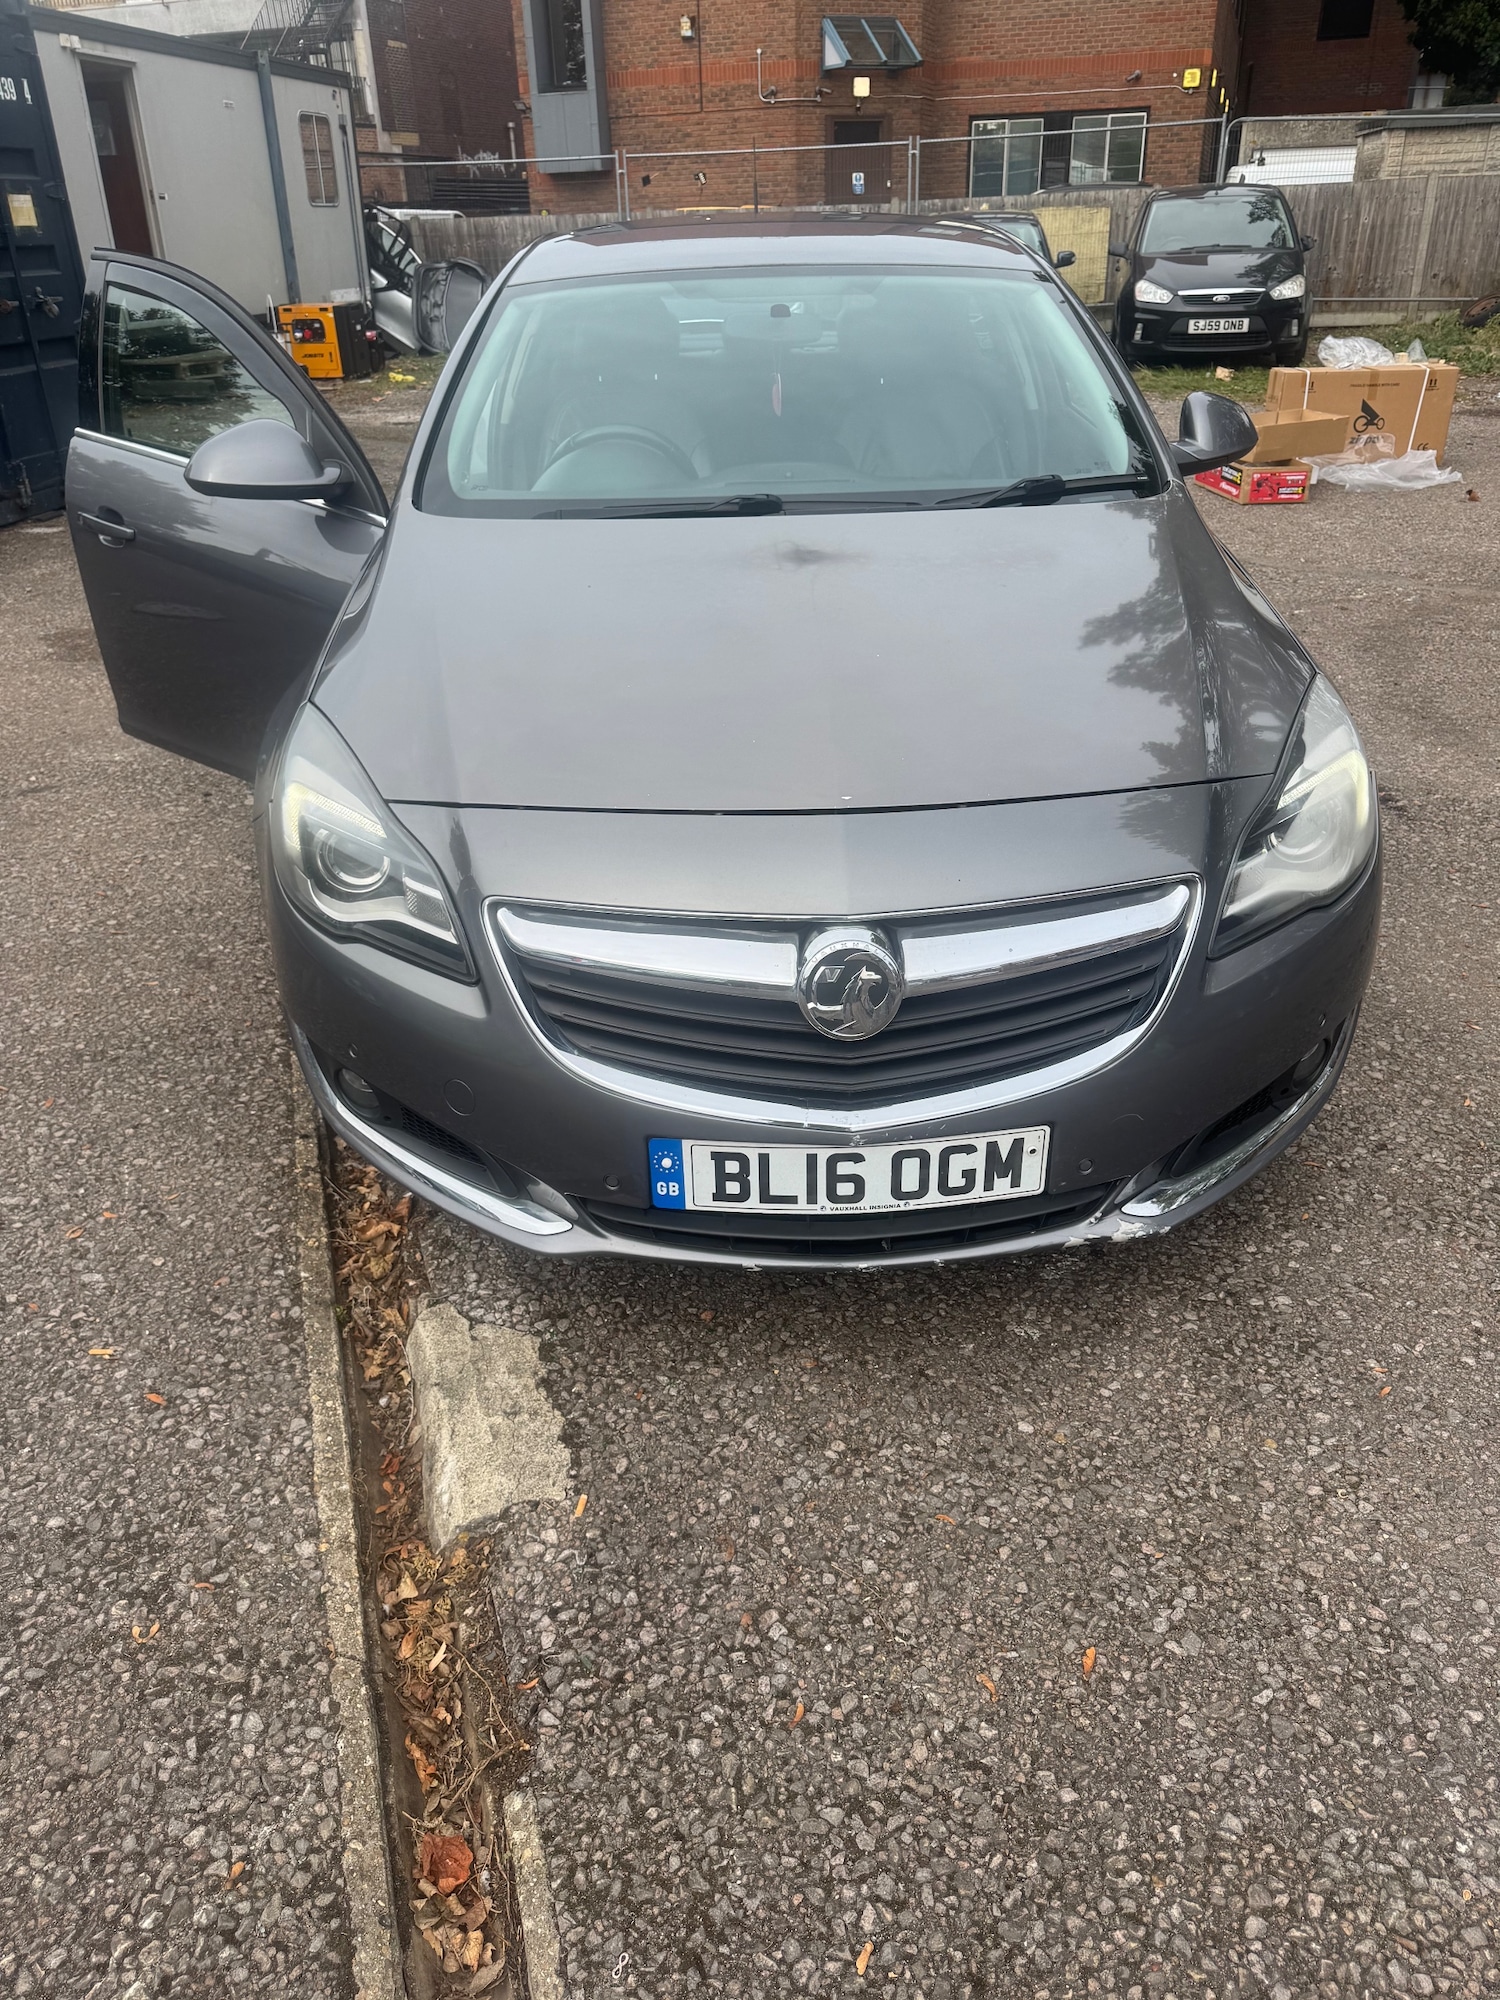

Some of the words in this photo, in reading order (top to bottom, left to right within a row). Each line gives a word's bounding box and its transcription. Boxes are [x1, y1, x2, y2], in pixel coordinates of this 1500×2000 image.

[1193, 320, 1220, 331] SJ59
[1223, 320, 1244, 331] ONB
[811, 942, 890, 963] VAUXHALL
[710, 1151, 867, 1204] BL16
[890, 1137, 1025, 1201] OGM
[656, 1182, 680, 1196] GB
